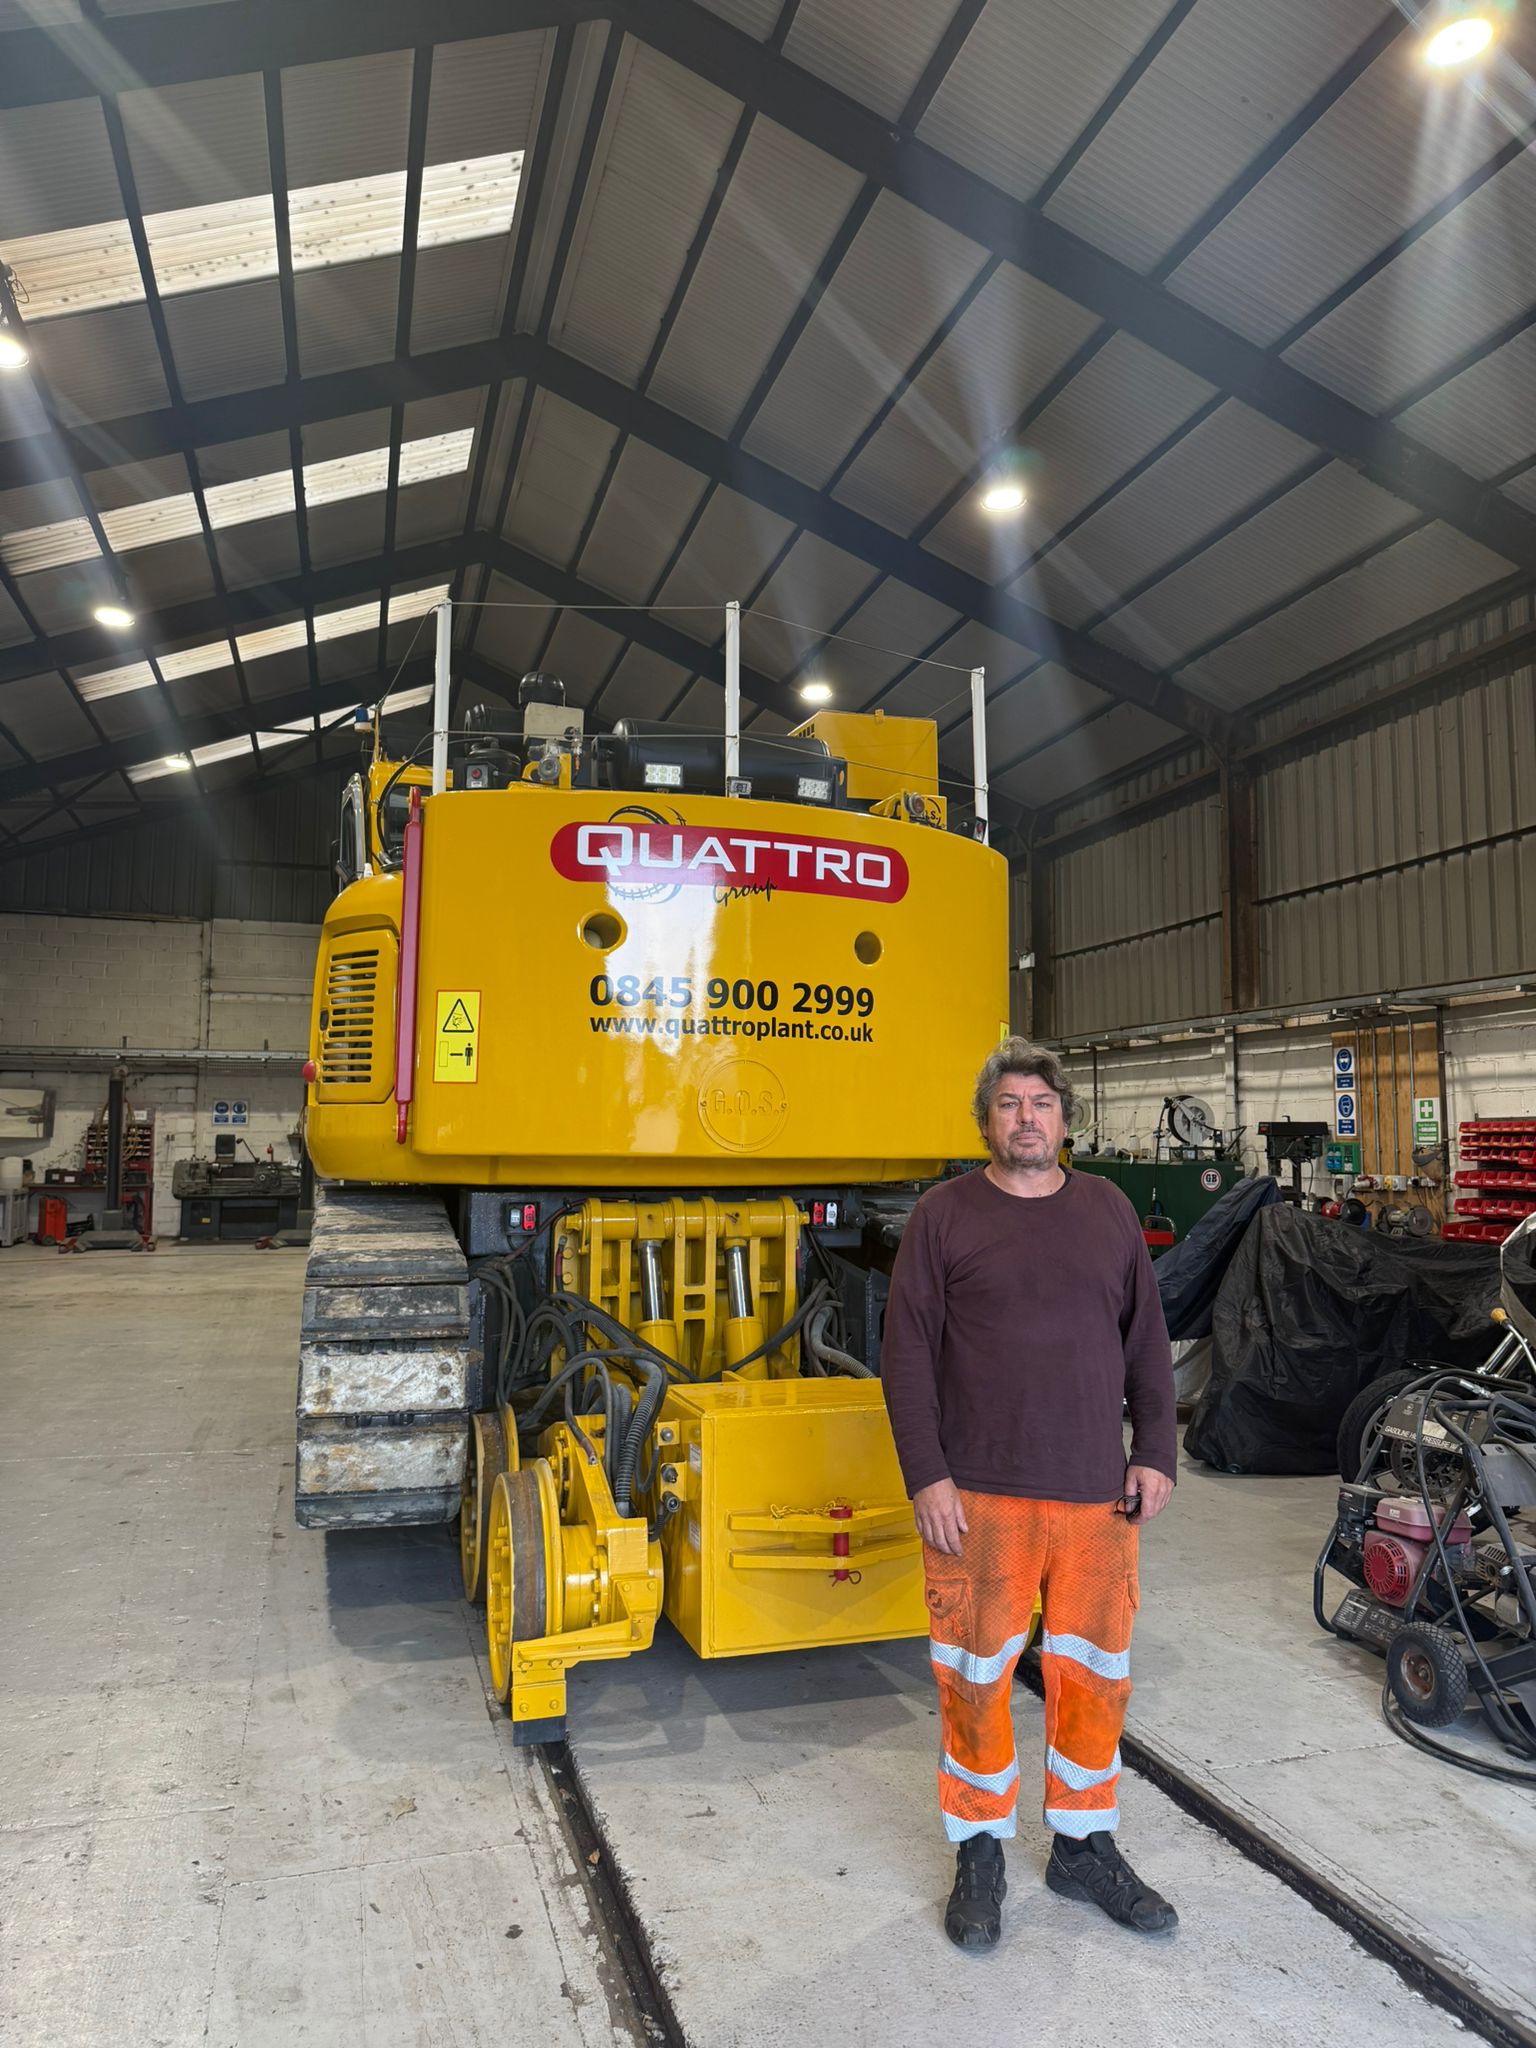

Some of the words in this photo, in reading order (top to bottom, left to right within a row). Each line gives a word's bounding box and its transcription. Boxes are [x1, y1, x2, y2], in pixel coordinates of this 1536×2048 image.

[577, 824, 892, 889] QUATTRO
[713, 877, 777, 906] Group
[590, 974, 692, 1007] 0845
[706, 978, 779, 1011] 900
[792, 982, 874, 1017] 2999
[590, 1016, 874, 1042] www.quattroplant.co.uk
[1205, 1173, 1218, 1183] GB
[1384, 1425, 1410, 1438] GASOLINE
[1422, 1436, 1450, 1449] PRESSURE
